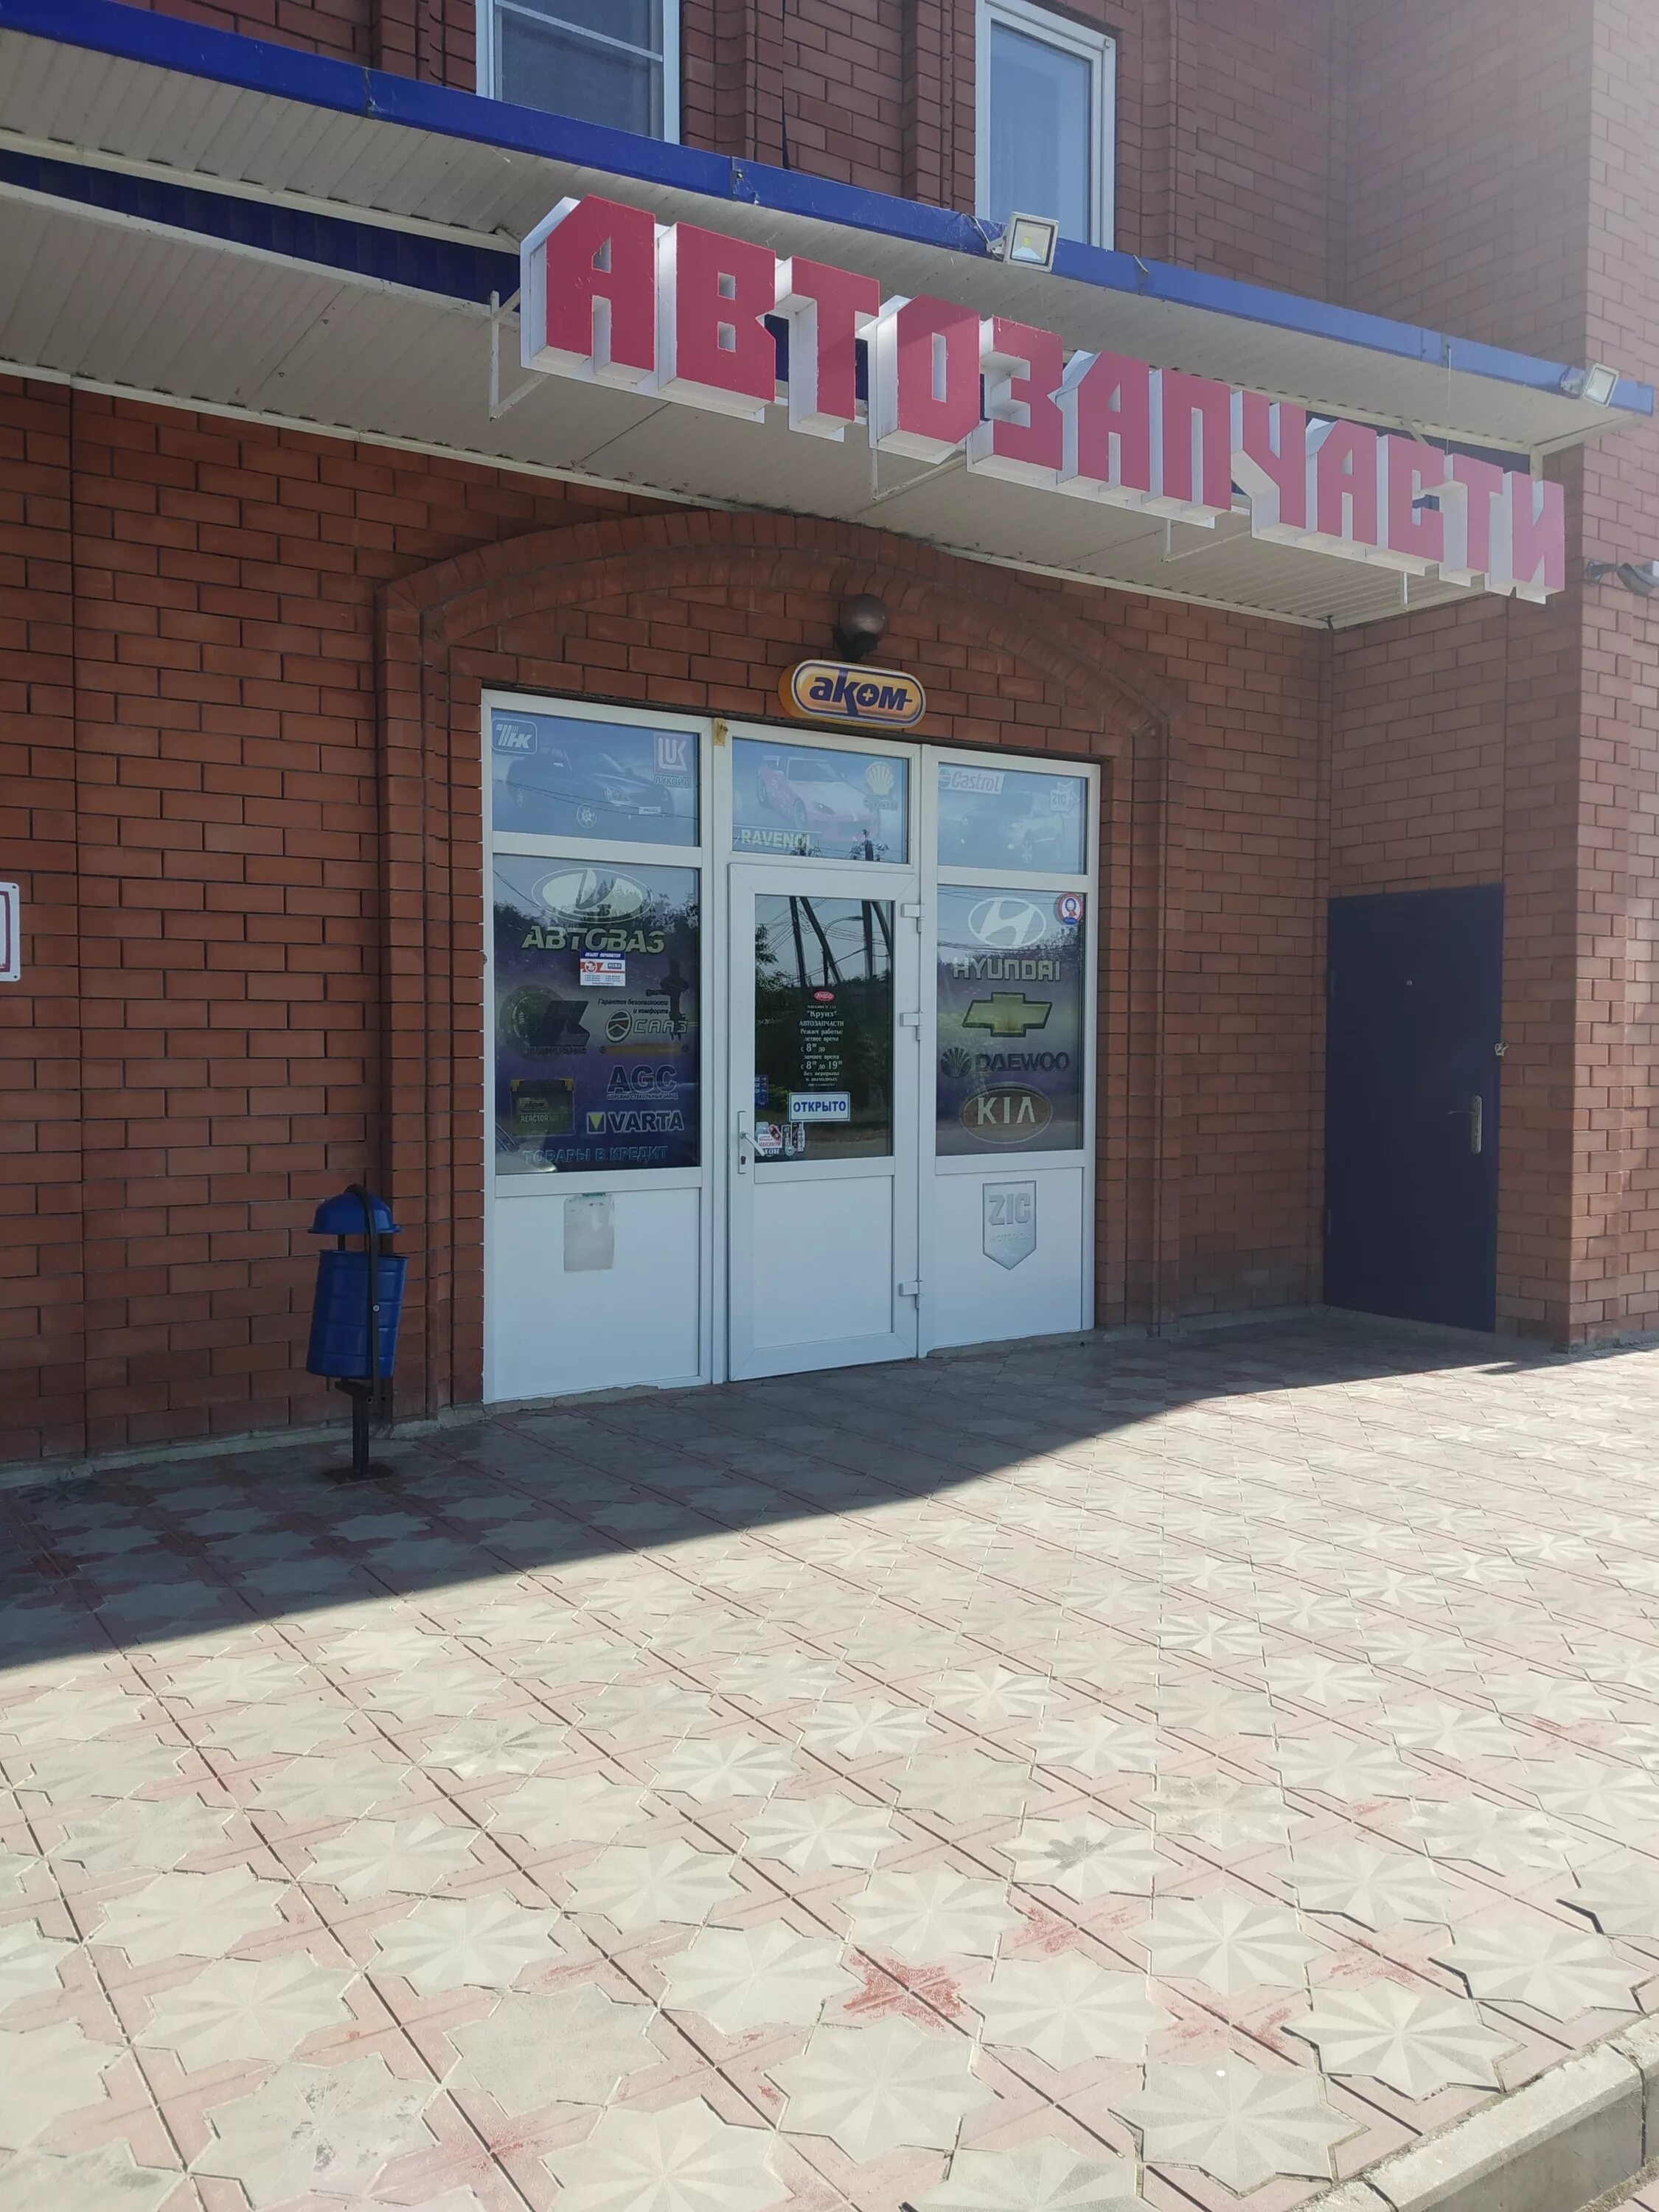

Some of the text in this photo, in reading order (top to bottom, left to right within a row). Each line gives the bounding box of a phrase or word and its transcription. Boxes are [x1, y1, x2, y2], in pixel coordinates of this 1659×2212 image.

[521, 193, 1565, 604] АВТОЗАПЧАСТИ
[653, 775, 692, 787] ЛУКОЙЛ
[950, 771, 1001, 793] Castrol
[740, 829, 812, 849] RAVENOL
[521, 925, 666, 954] АВТОВАЗ
[952, 957, 1061, 981] HYUNDAI
[598, 998, 627, 1006] Гарантия
[638, 1007, 669, 1015] комфорта
[799, 1020, 844, 1028] АВТОЗАПЧАСТИ
[975, 1051, 1070, 1071] DAEWOO
[607, 1064, 678, 1093] AGC
[793, 1100, 846, 1113] ОТКРЫТО
[977, 1096, 1037, 1125] KIA
[608, 1110, 684, 1133] VARTA
[523, 1146, 668, 1164] ТОВАРЫ В КРЕДИТ
[988, 1192, 1031, 1227] ZIC
